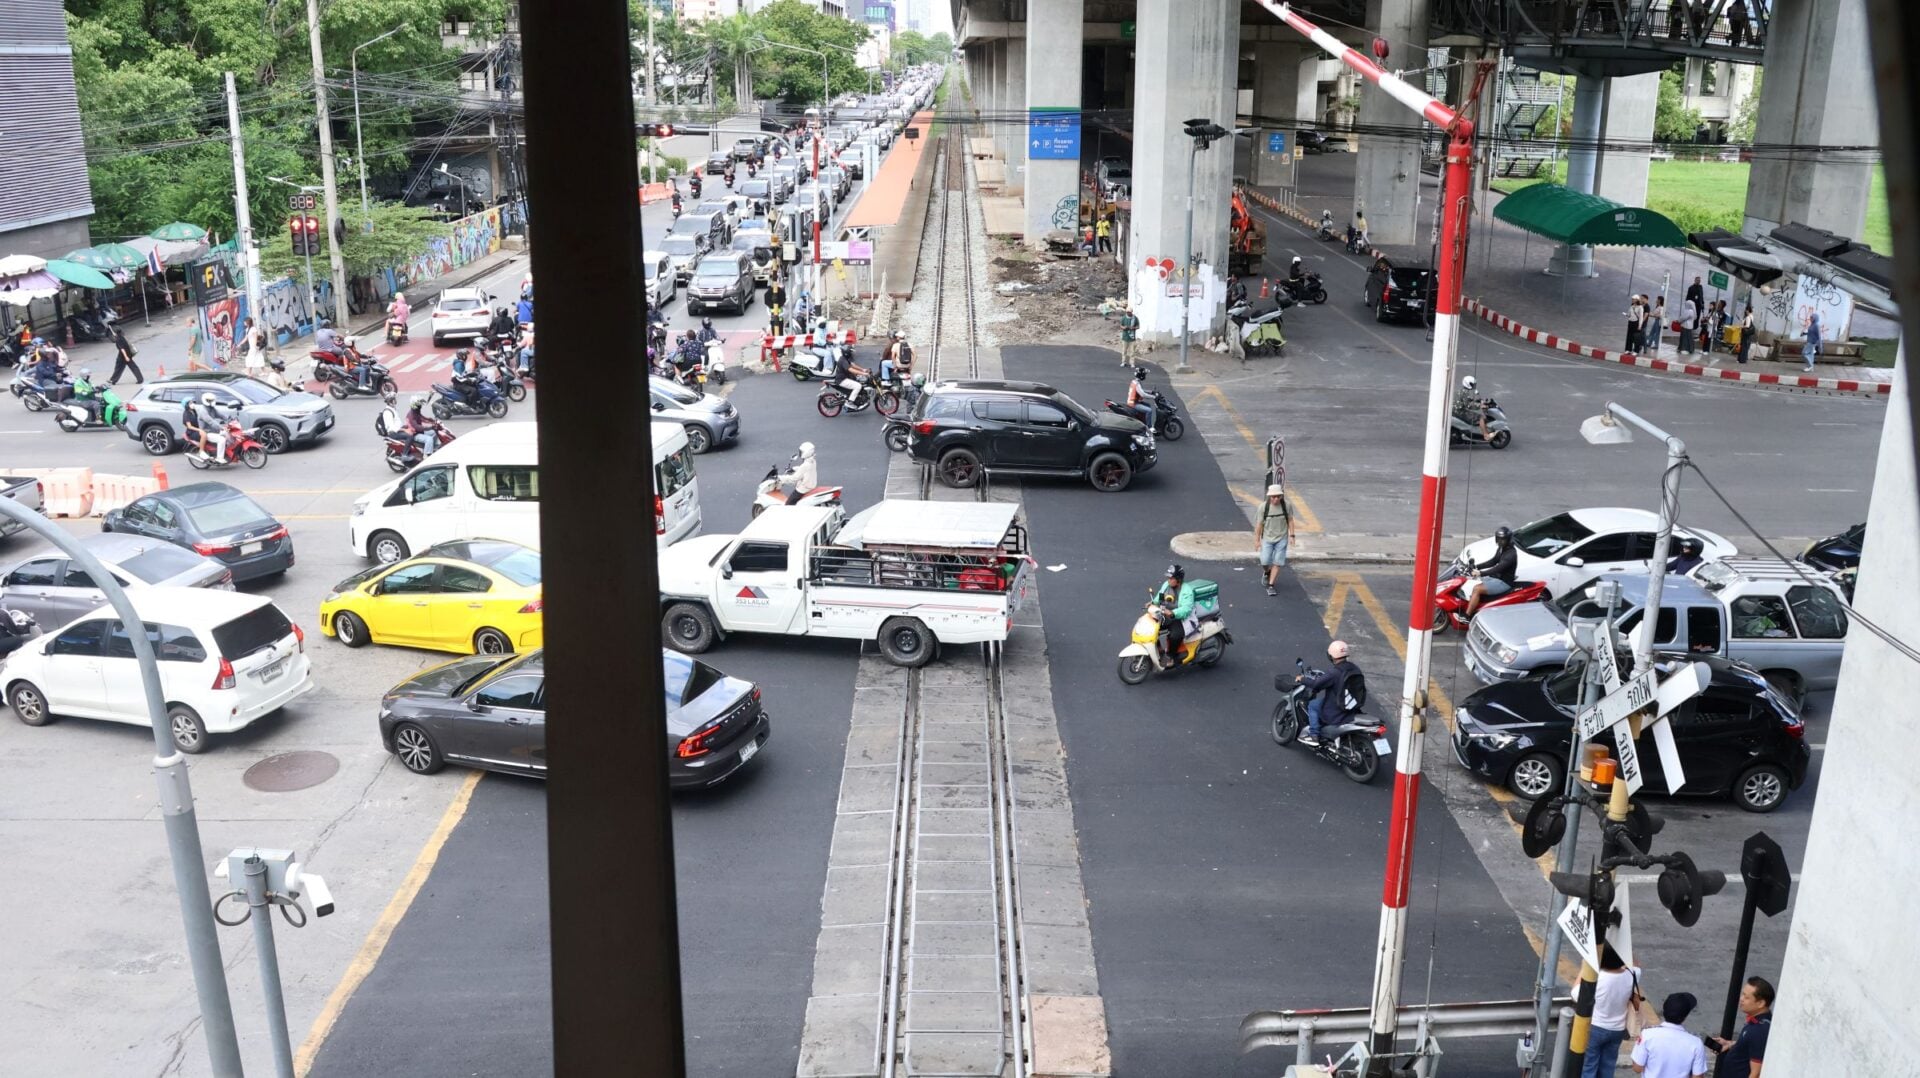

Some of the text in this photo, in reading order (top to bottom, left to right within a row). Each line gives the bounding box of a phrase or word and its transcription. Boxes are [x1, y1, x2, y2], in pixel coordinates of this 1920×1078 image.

[1584, 675, 1652, 737] ระวัง รถไฟ
[1598, 637, 1638, 782] ระวัง รถไฟ
